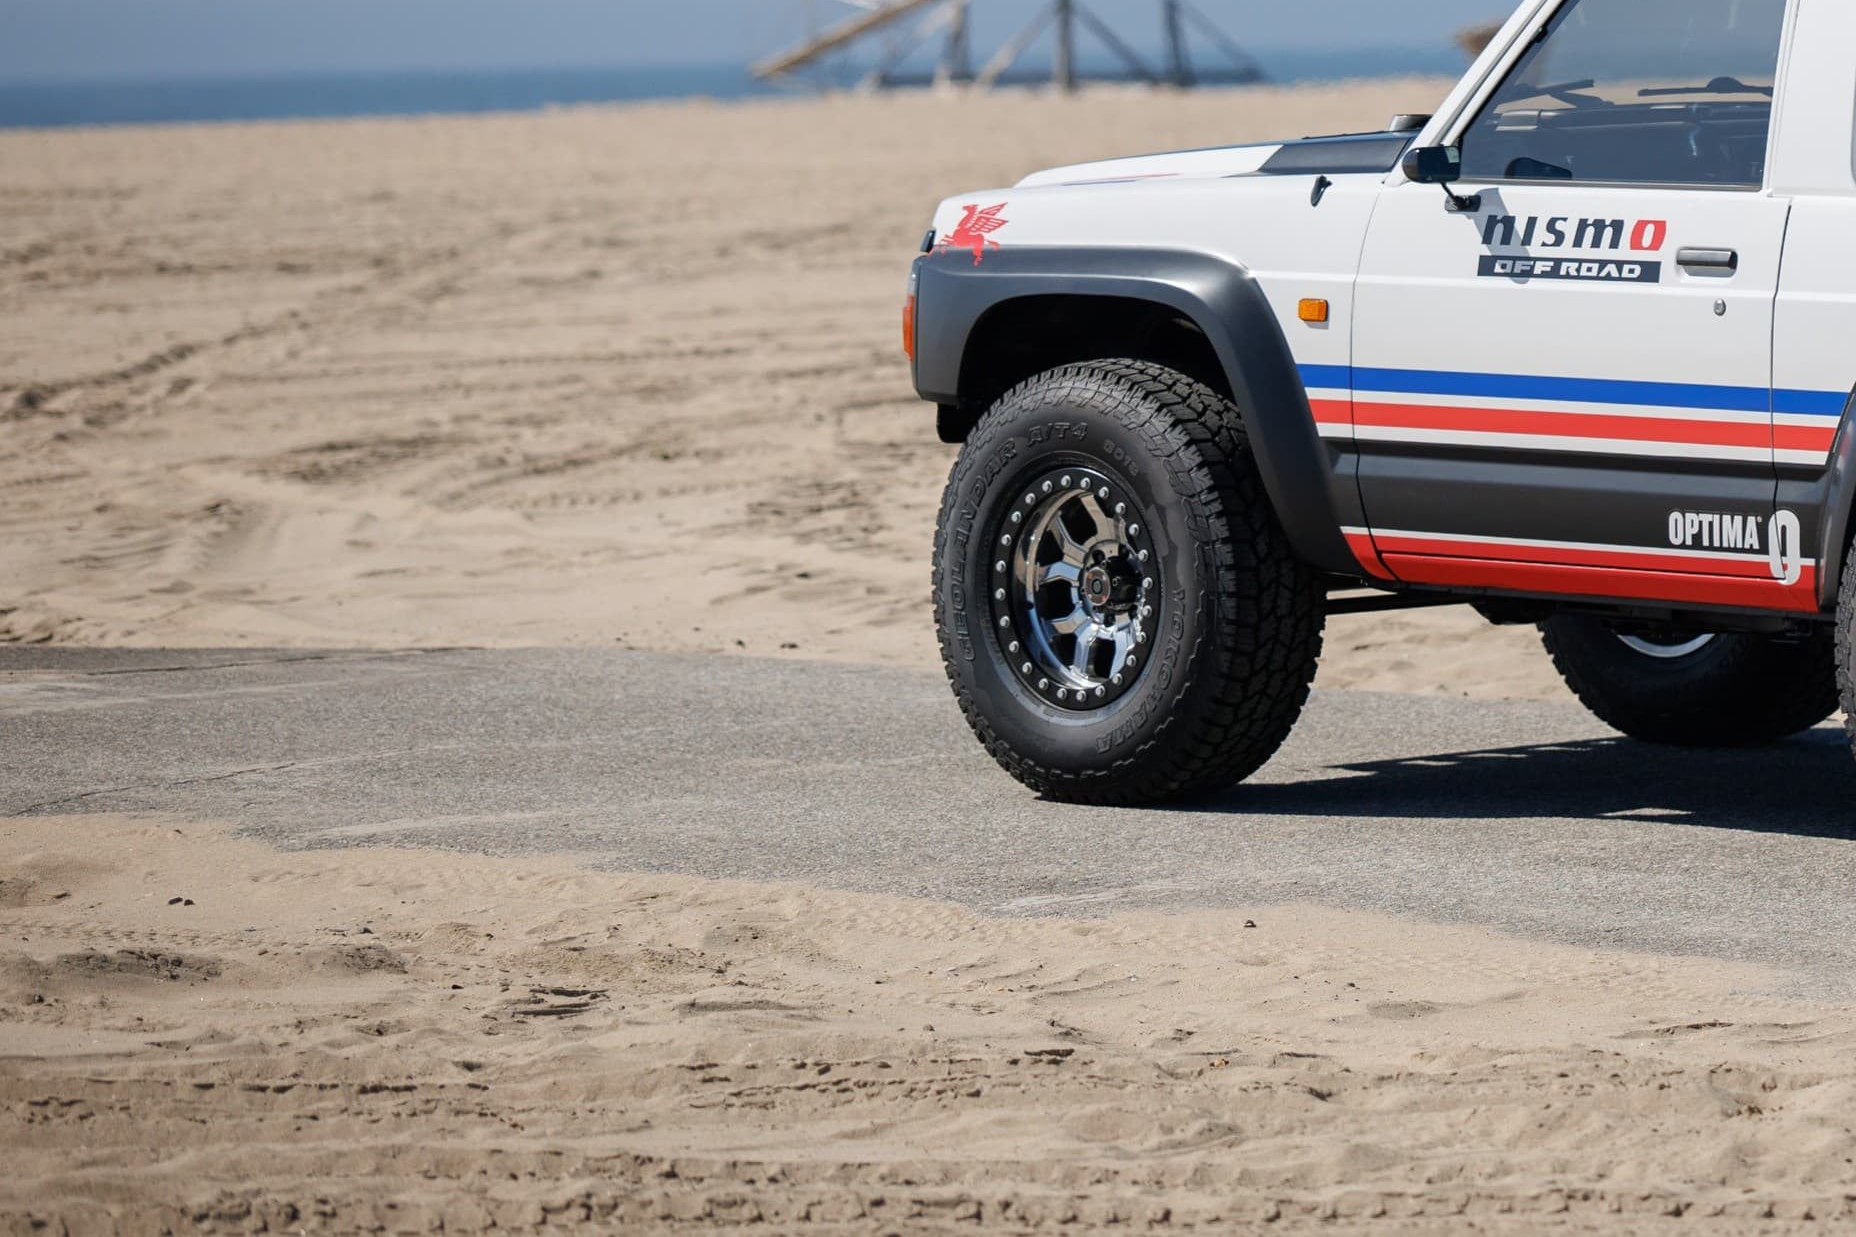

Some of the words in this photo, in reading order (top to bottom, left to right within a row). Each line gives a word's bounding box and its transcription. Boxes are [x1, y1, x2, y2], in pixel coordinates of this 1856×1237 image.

[1481, 214, 1667, 252] nismo
[1493, 259, 1553, 276] OFF
[1559, 261, 1642, 279] ROAD
[952, 436, 1019, 661] GEOLANDAR
[1668, 510, 1760, 550] OPTIMA
[1096, 584, 1186, 754] YOKOHAMA
